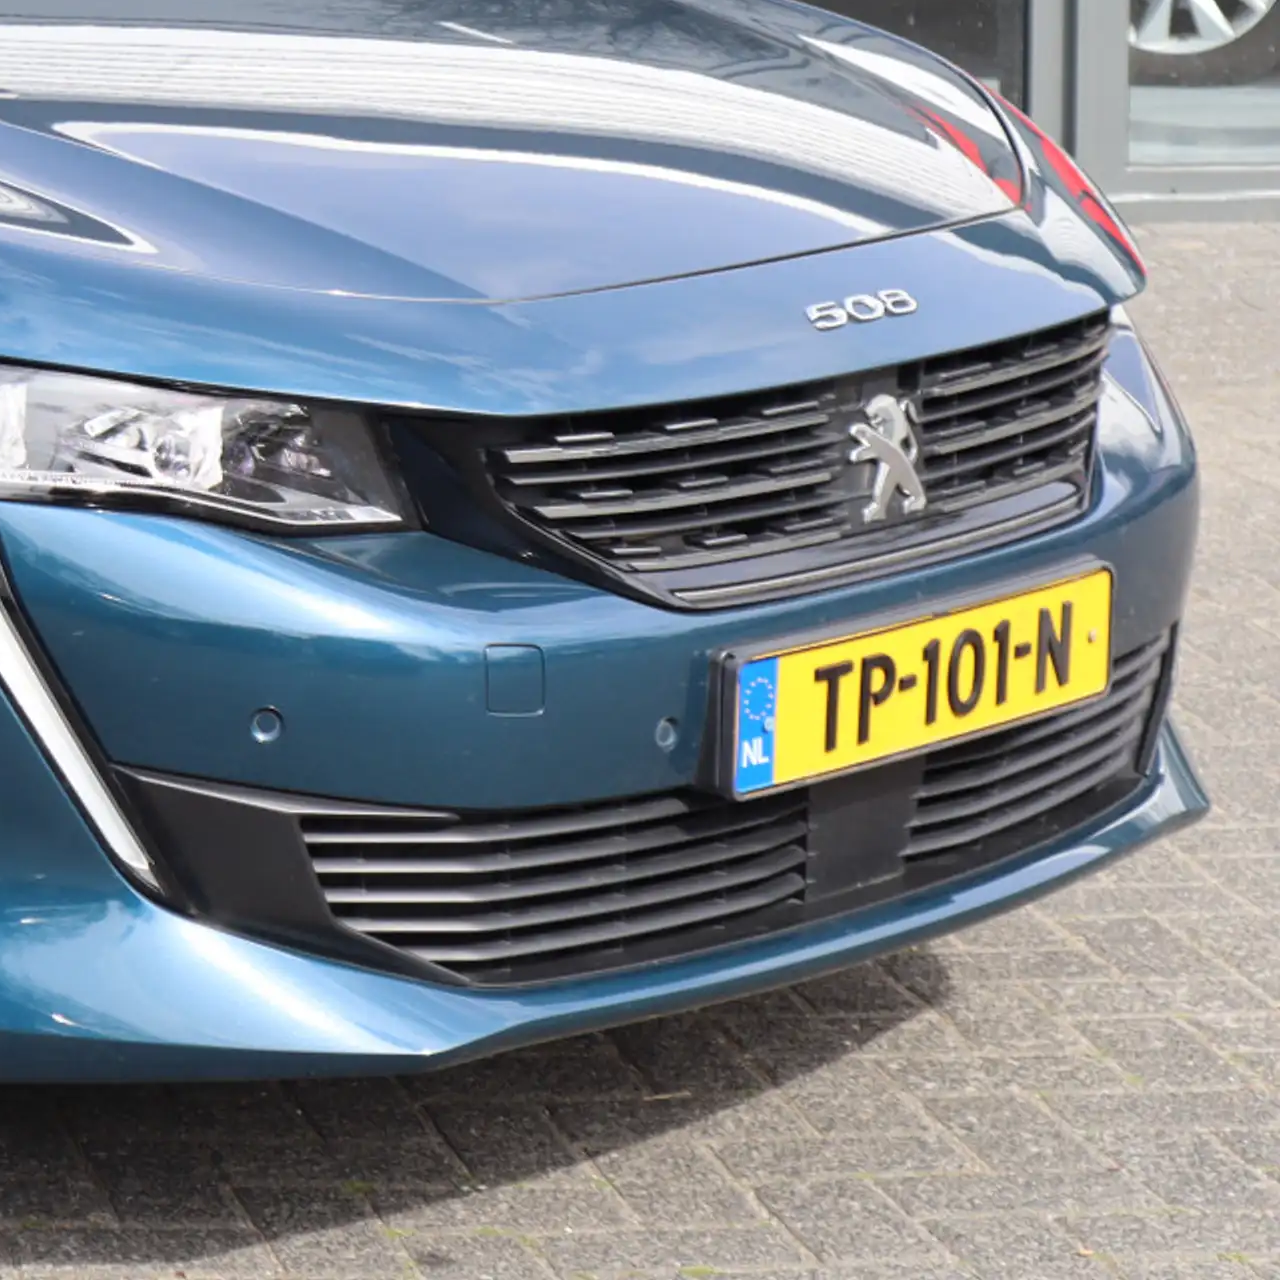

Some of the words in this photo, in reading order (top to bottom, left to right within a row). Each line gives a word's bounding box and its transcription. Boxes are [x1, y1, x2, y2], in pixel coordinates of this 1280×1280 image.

[805, 288, 917, 330] 508
[814, 600, 1073, 753] TP-101-N
[742, 736, 769, 768] NL
